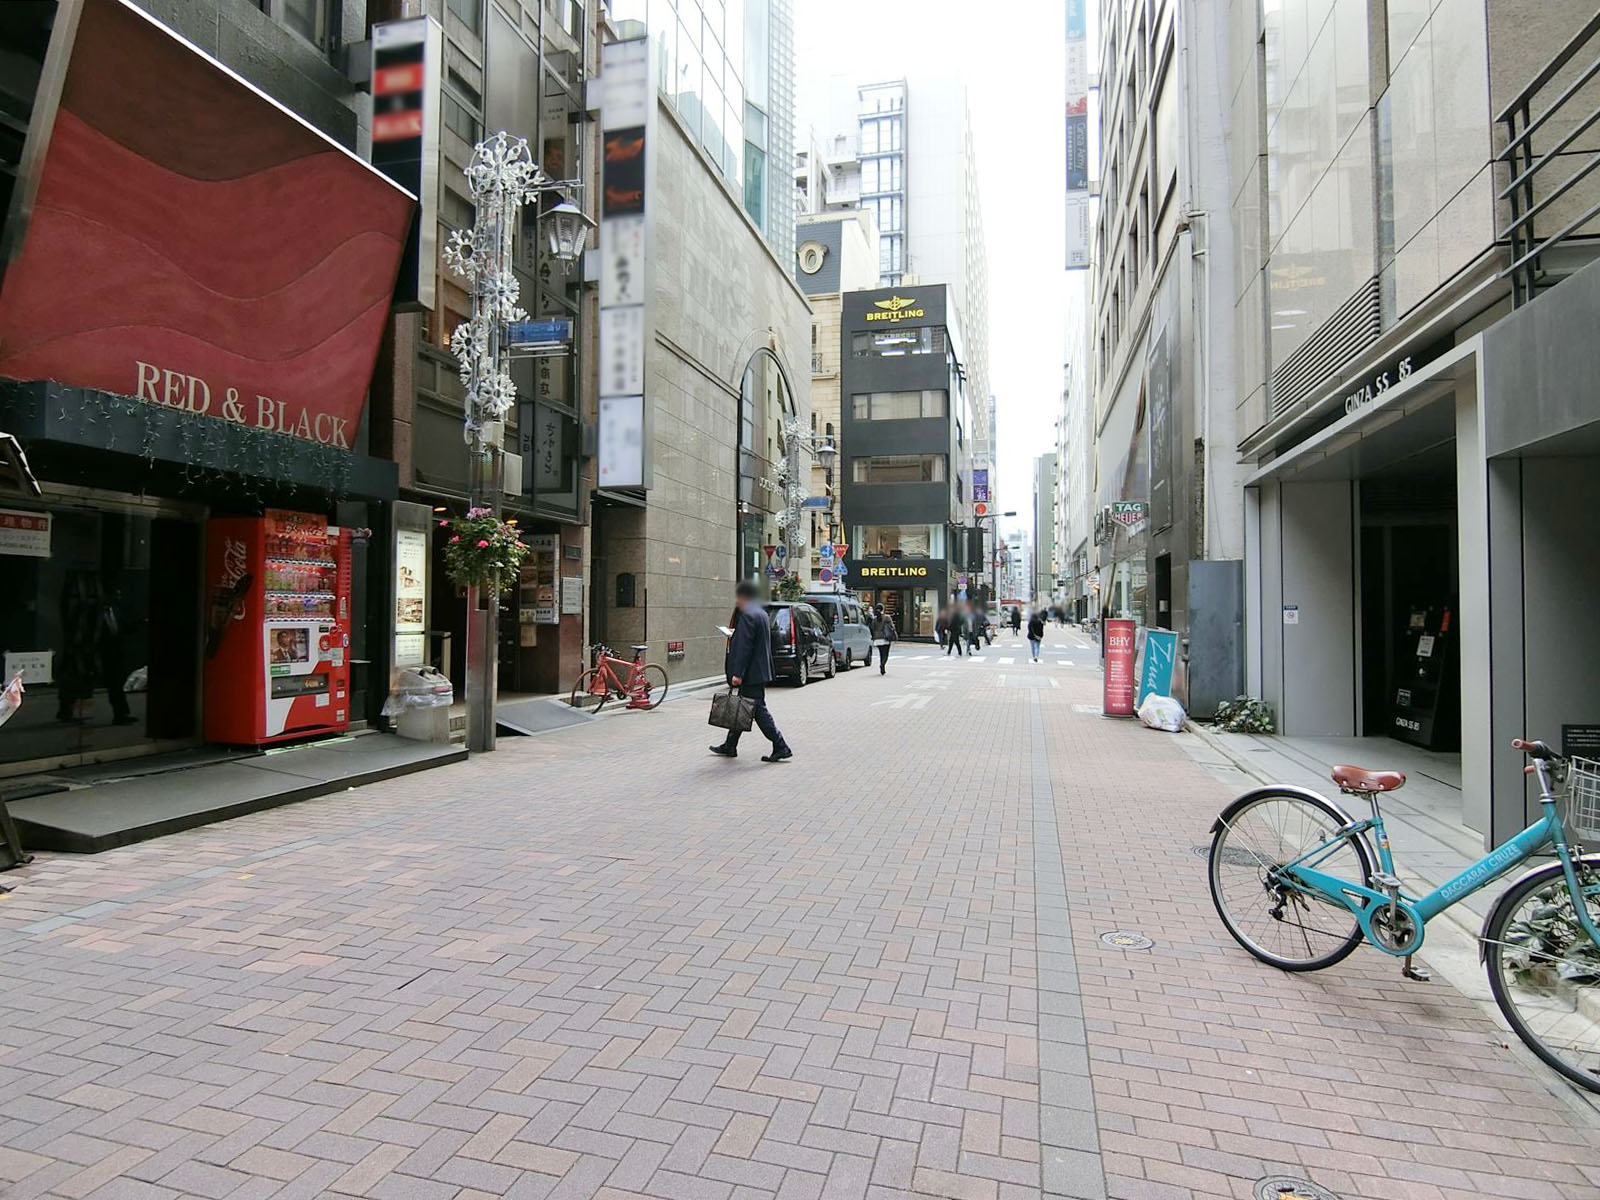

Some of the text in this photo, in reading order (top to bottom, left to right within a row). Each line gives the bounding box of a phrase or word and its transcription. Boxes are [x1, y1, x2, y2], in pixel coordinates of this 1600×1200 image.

[866, 309, 924, 321] BREITLING
[1345, 356, 1412, 415] GINZA SS 85
[135, 360, 349, 449] RED & BLACK
[1115, 503, 1141, 511] TAG
[1114, 512, 1142, 525] HEUER
[861, 567, 927, 576] BREITLING
[1109, 636, 1130, 646] BHY
[1488, 843, 1519, 867] CRUZE
